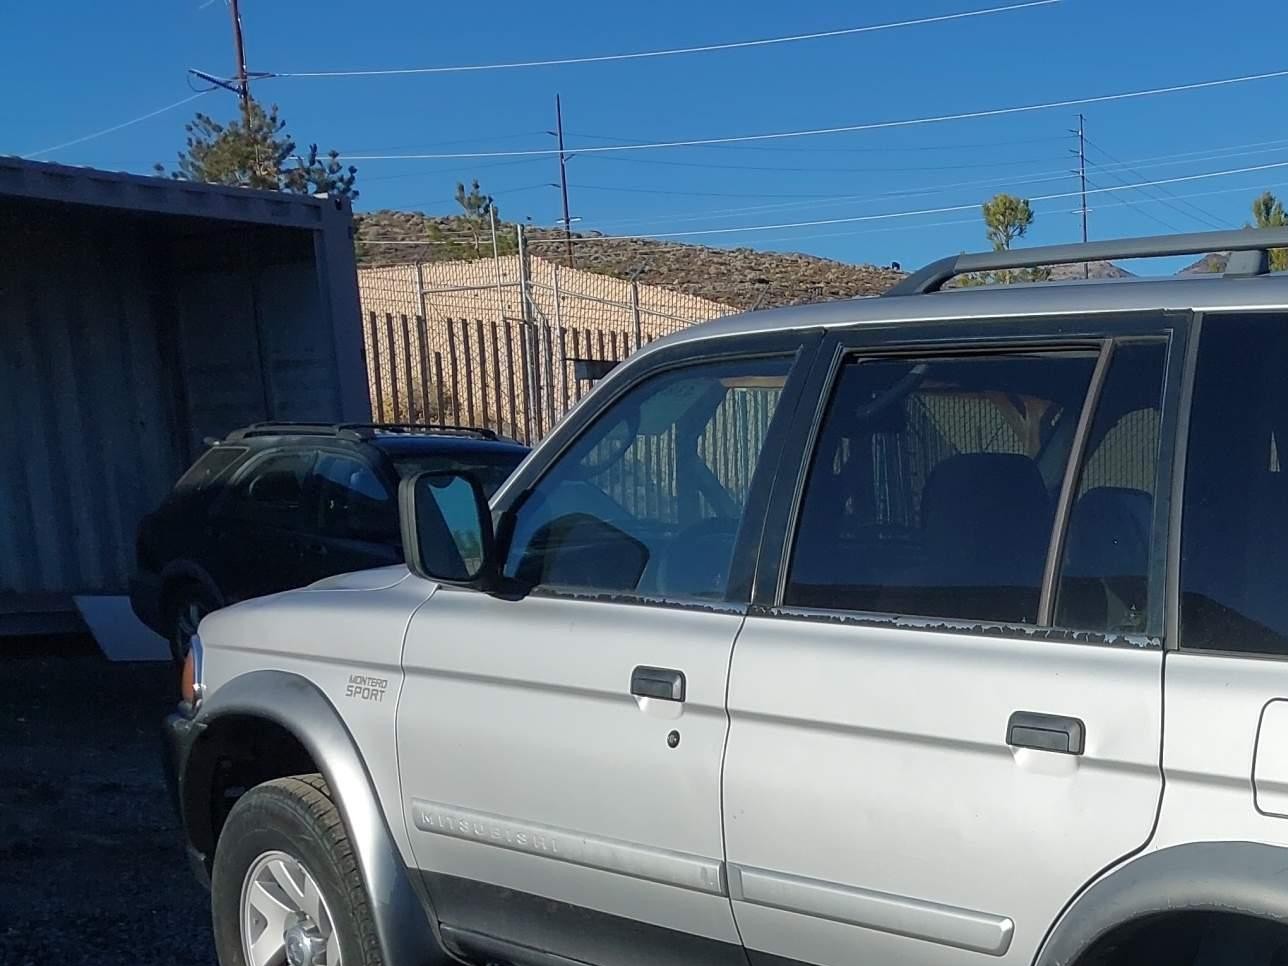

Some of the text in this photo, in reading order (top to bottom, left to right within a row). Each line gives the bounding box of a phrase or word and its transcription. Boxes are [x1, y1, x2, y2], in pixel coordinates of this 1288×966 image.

[349, 674, 388, 689] MONTERO
[345, 685, 386, 702] SPORT
[421, 810, 558, 853] MITSUBISHI
